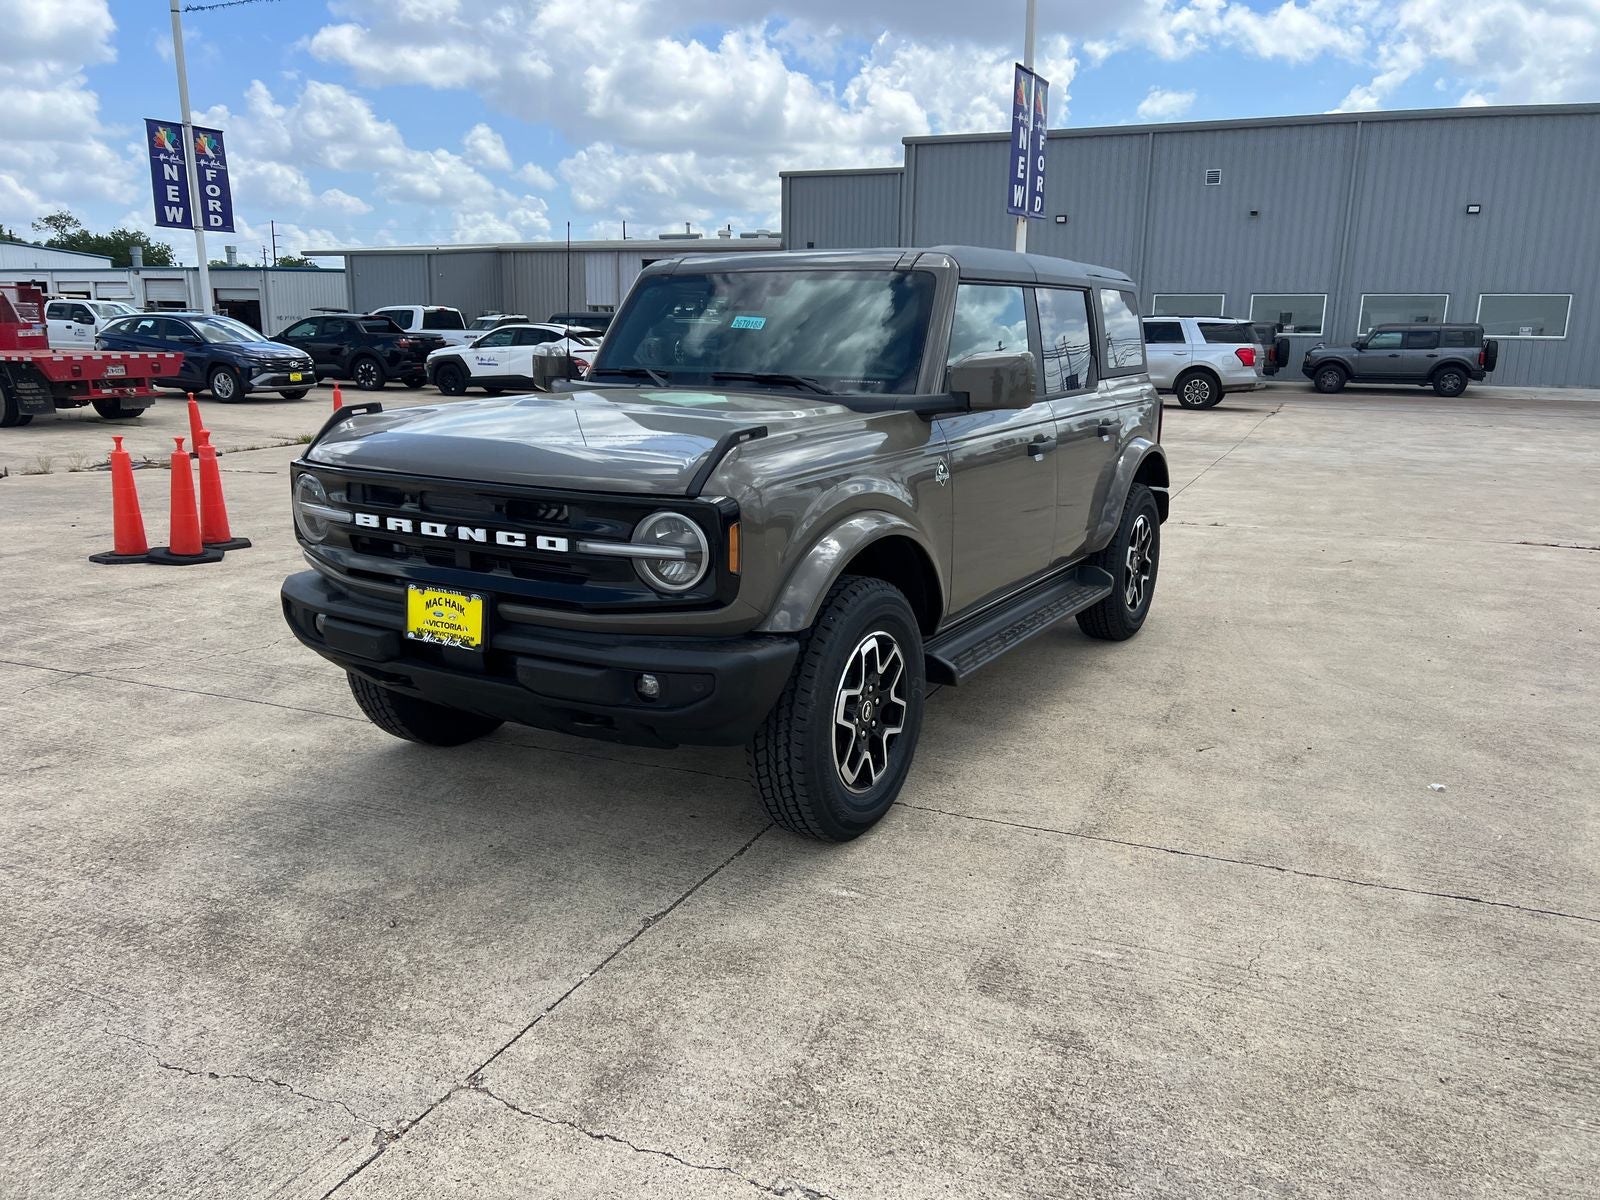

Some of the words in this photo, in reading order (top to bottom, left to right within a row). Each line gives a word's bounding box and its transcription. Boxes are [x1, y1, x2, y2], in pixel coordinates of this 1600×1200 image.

[1013, 127, 1027, 208] NEW
[1034, 134, 1045, 212] FORD
[163, 163, 184, 223] NEW
[205, 169, 223, 227] FORD
[355, 512, 569, 552] BRONCO
[425, 597, 443, 611] MAC
[444, 598, 465, 616] HAIK
[429, 619, 462, 632] VICTORIA
[421, 632, 441, 643] Mac
[442, 636, 465, 648] Haik
